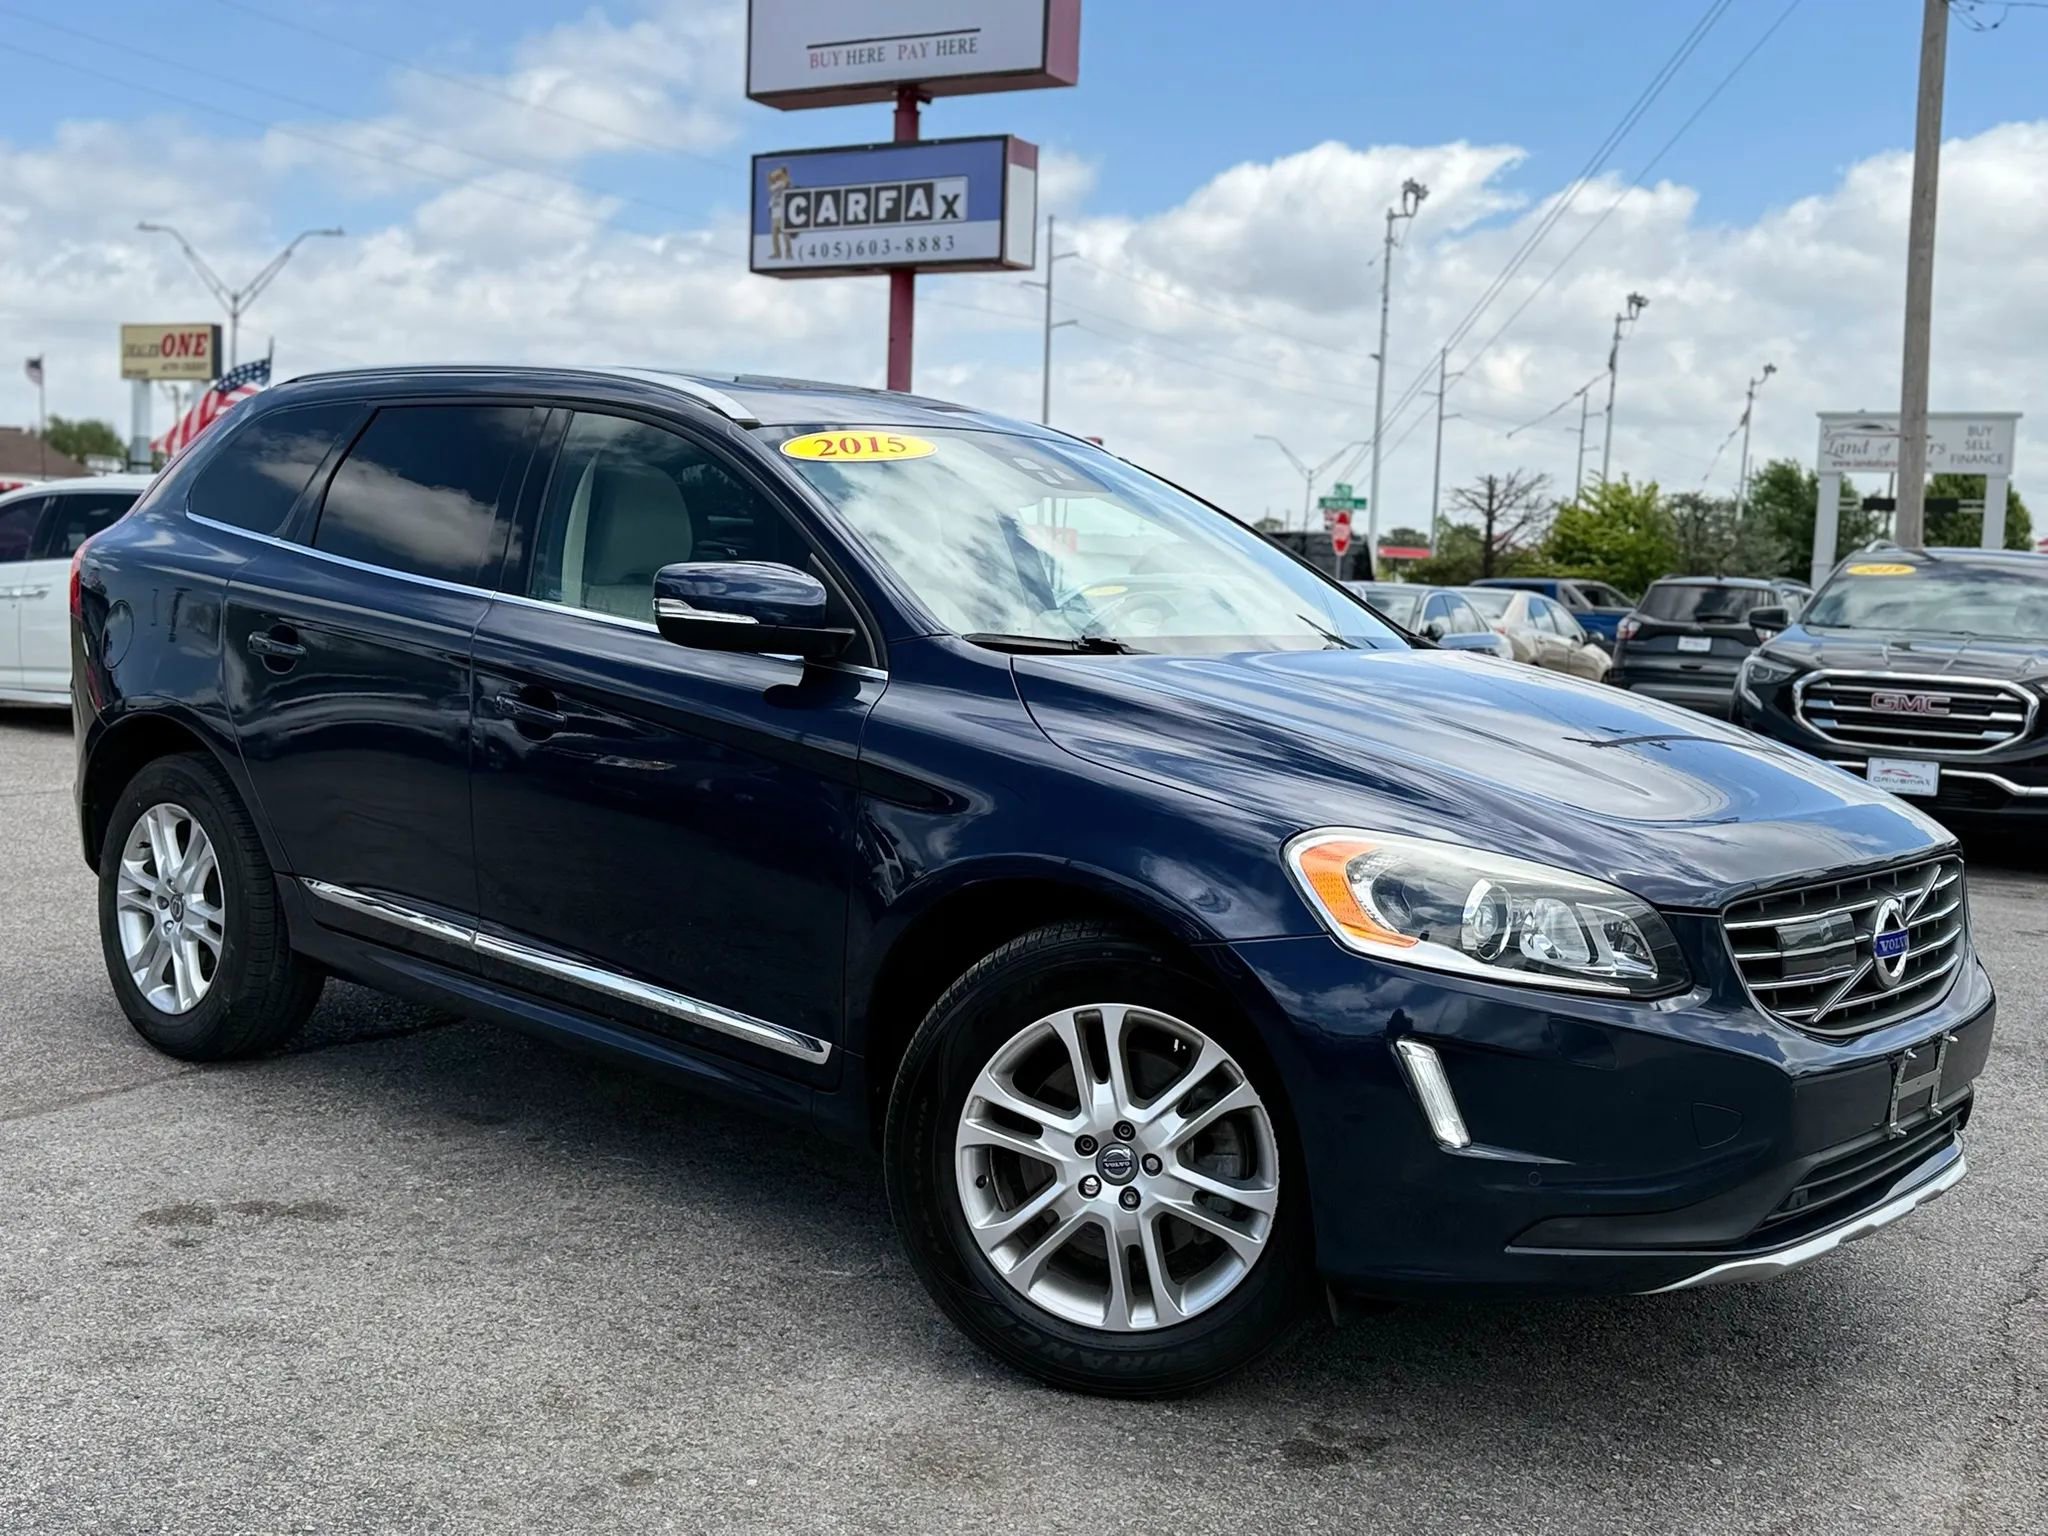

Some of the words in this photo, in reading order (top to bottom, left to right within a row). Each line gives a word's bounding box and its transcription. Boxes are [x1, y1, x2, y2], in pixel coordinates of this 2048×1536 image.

[809, 50, 842, 69] BUY
[846, 47, 886, 66] HERE
[898, 43, 930, 61] PAY
[936, 37, 978, 57] HERE
[798, 235, 956, 262] (405)603-8883
[161, 333, 208, 358] ONE
[1967, 425, 1994, 437] BUY
[814, 436, 906, 457] 2015
[1824, 440, 1869, 458] Land
[1965, 441, 1992, 451] SELL
[1951, 453, 2004, 465] FINANCE
[1871, 692, 1951, 716] GMC
